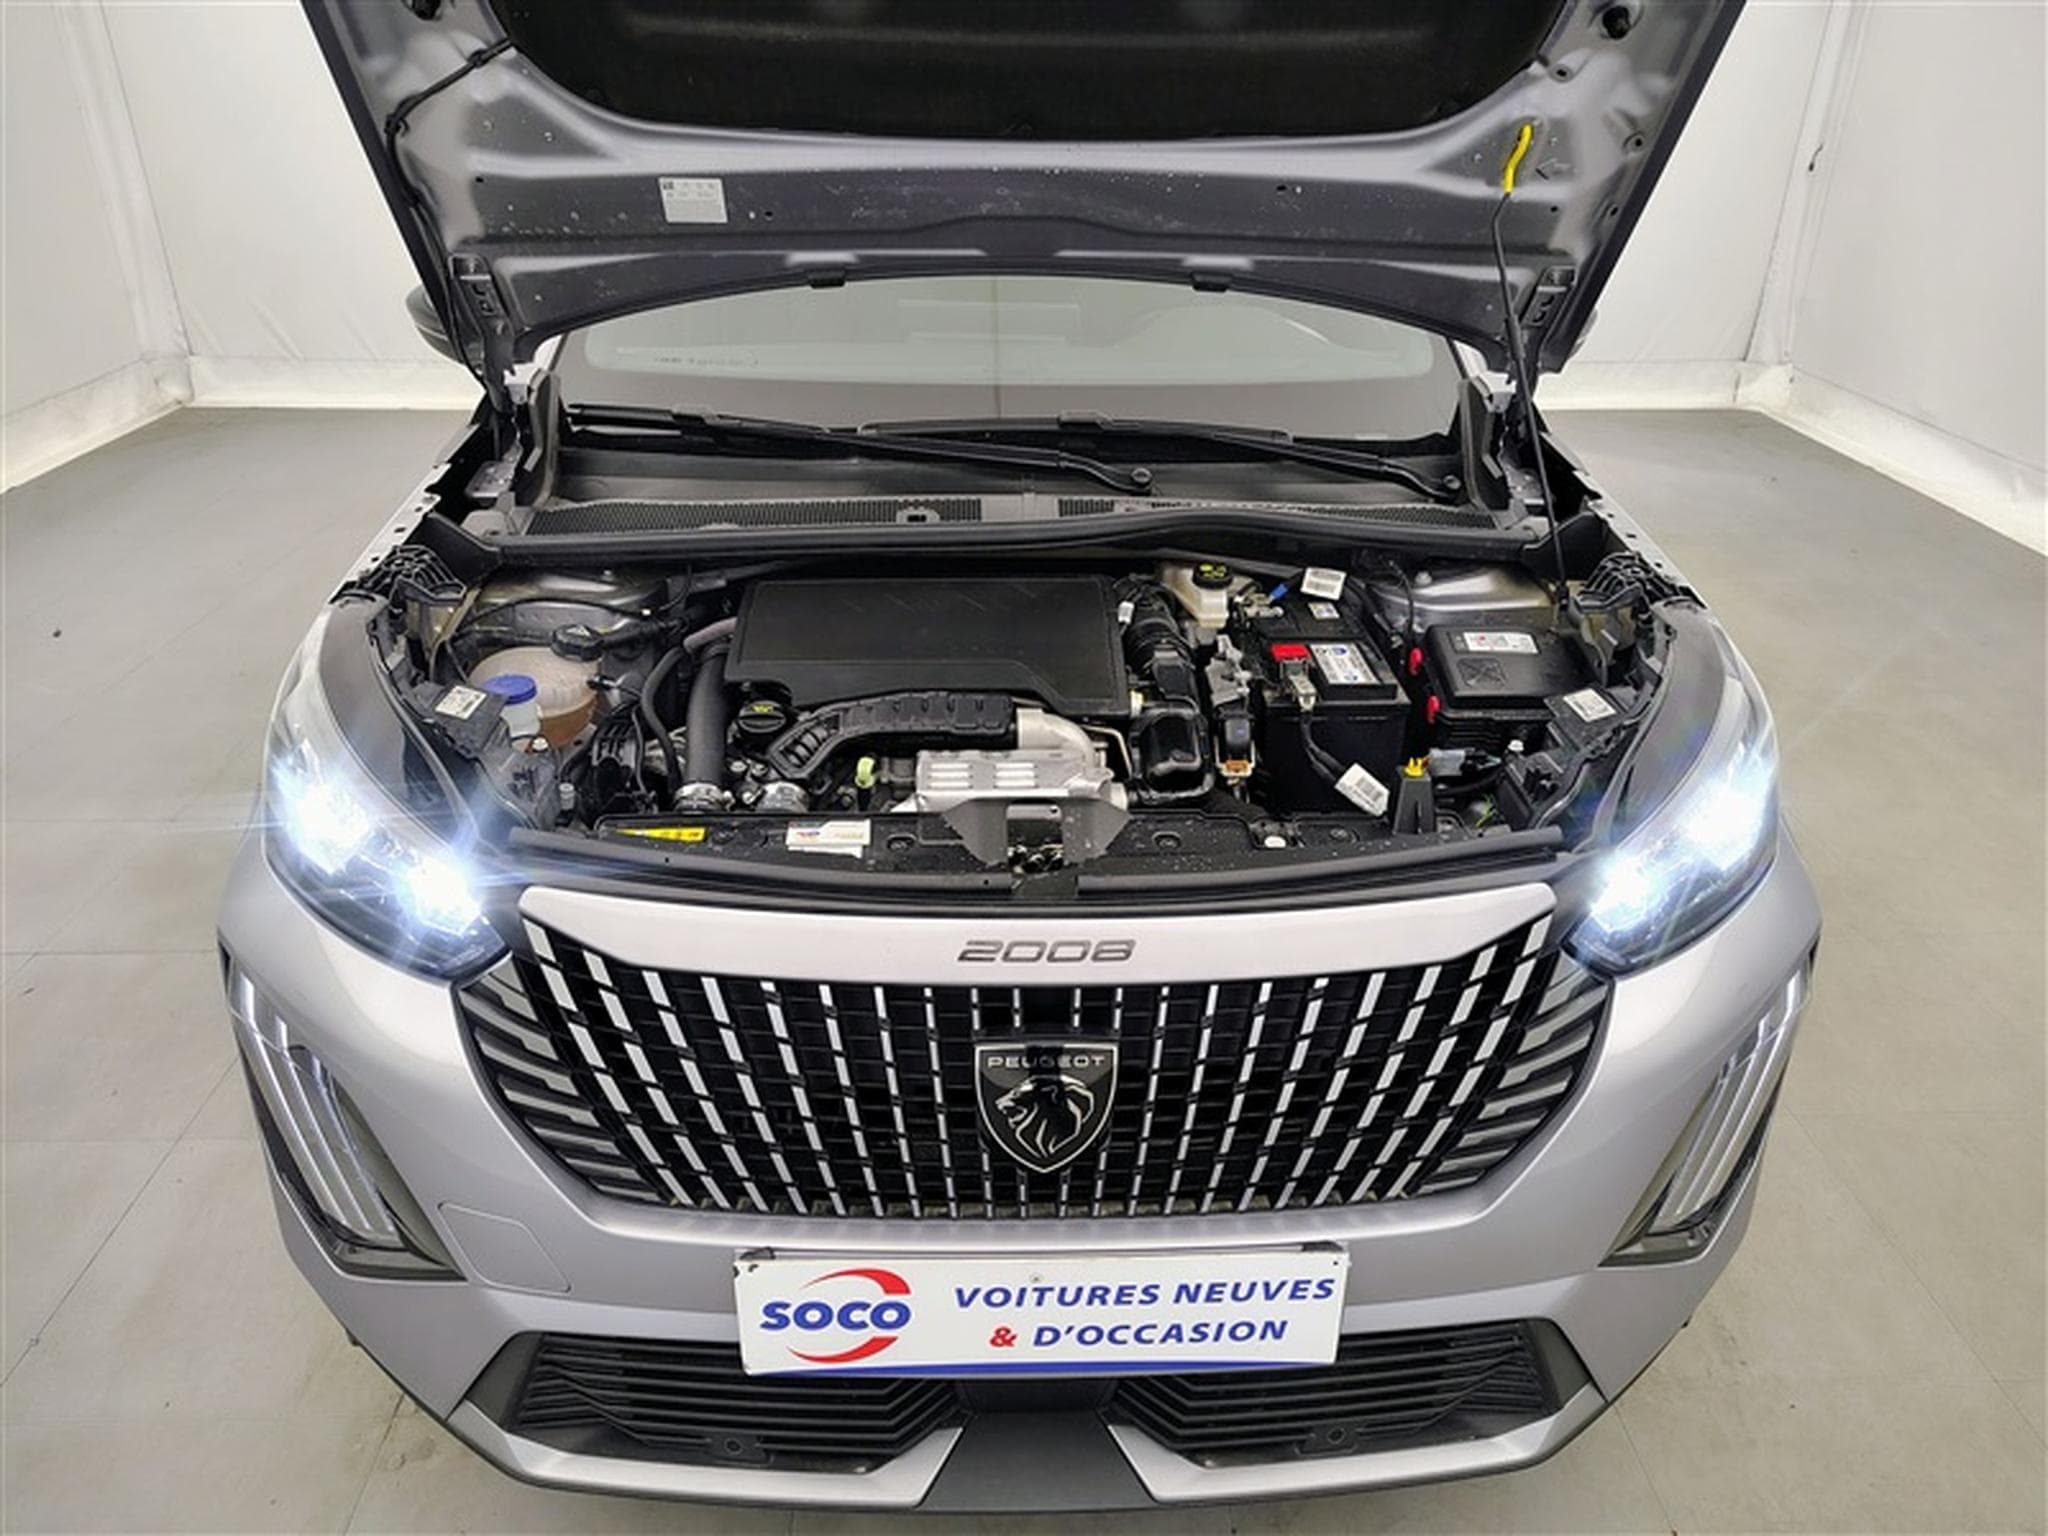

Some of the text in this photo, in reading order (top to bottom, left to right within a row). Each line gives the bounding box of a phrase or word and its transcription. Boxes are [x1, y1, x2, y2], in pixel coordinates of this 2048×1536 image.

[957, 939, 1136, 963] 2008
[987, 1055, 1105, 1069] PEUGEOT
[955, 1278, 1336, 1309] VOITURES NEUVES
[759, 1301, 912, 1331] SOCO
[989, 1320, 1289, 1348] & D'OCCASION
